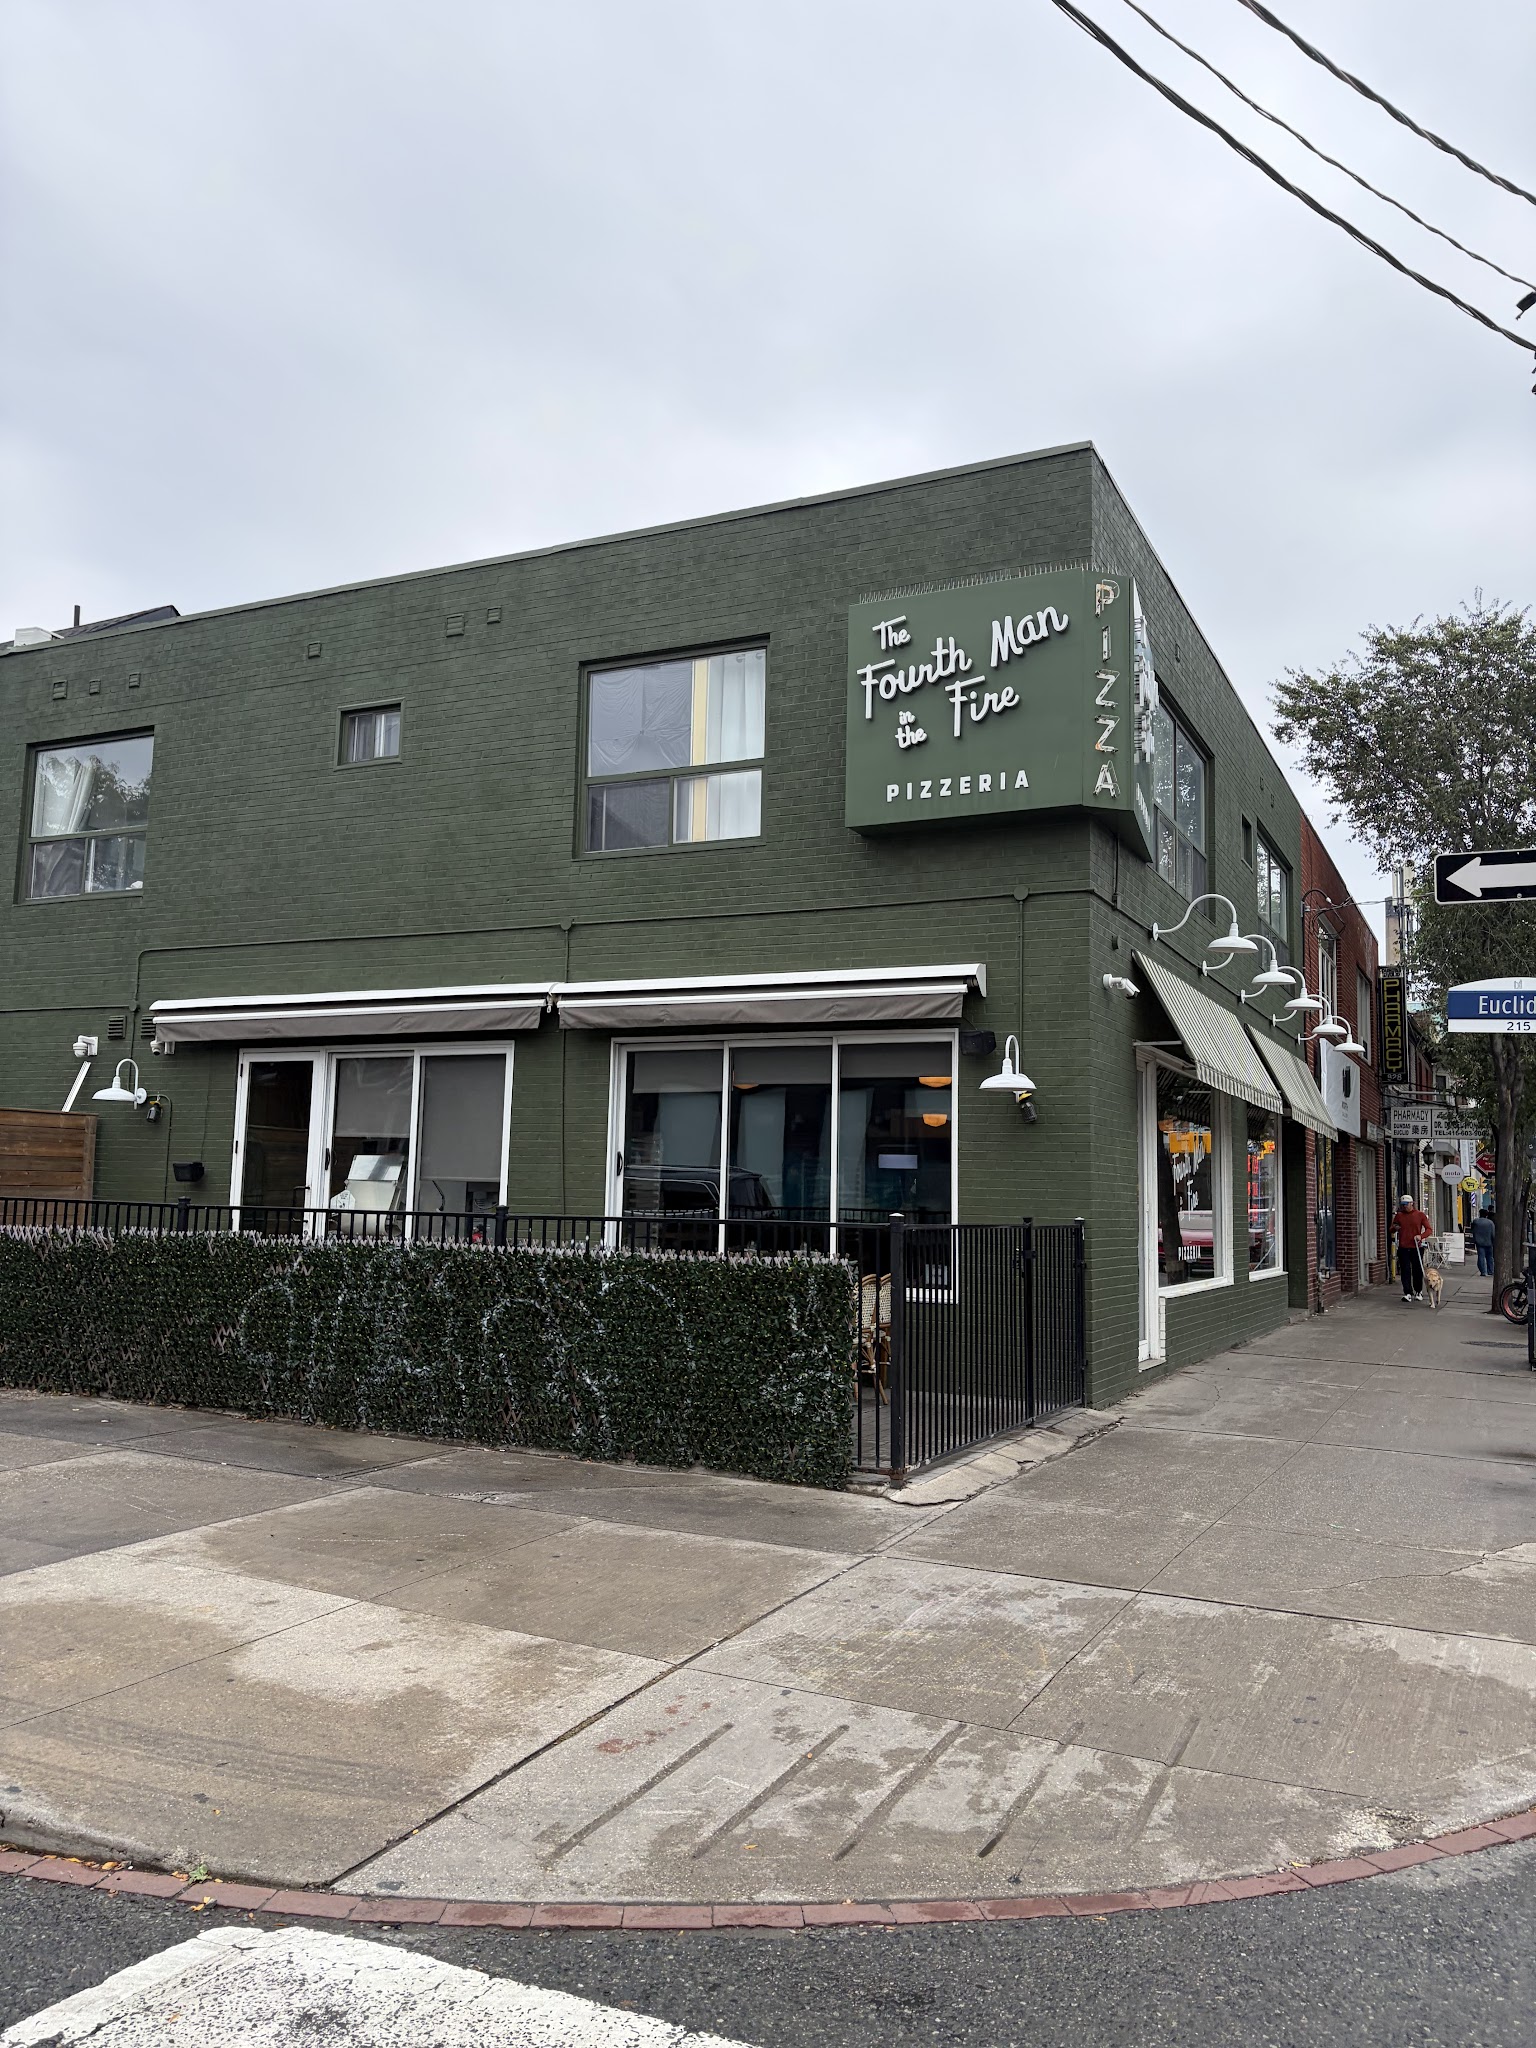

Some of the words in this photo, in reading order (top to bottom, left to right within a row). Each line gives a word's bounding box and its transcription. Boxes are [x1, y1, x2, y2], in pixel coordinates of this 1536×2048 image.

[872, 615, 911, 650] The
[857, 637, 973, 719] Fourth
[990, 606, 1069, 667] Man
[1093, 579, 1121, 798] PIZZA
[898, 711, 916, 725] in
[945, 675, 1020, 737] Fire
[895, 726, 927, 749] the
[886, 769, 1029, 802] PIZZERIA
[1478, 995, 1536, 1015] Euclid
[1383, 979, 1403, 1073] PHARMACY
[1506, 1021, 1531, 1031] 215
[1393, 1109, 1429, 1121] PHARMACY
